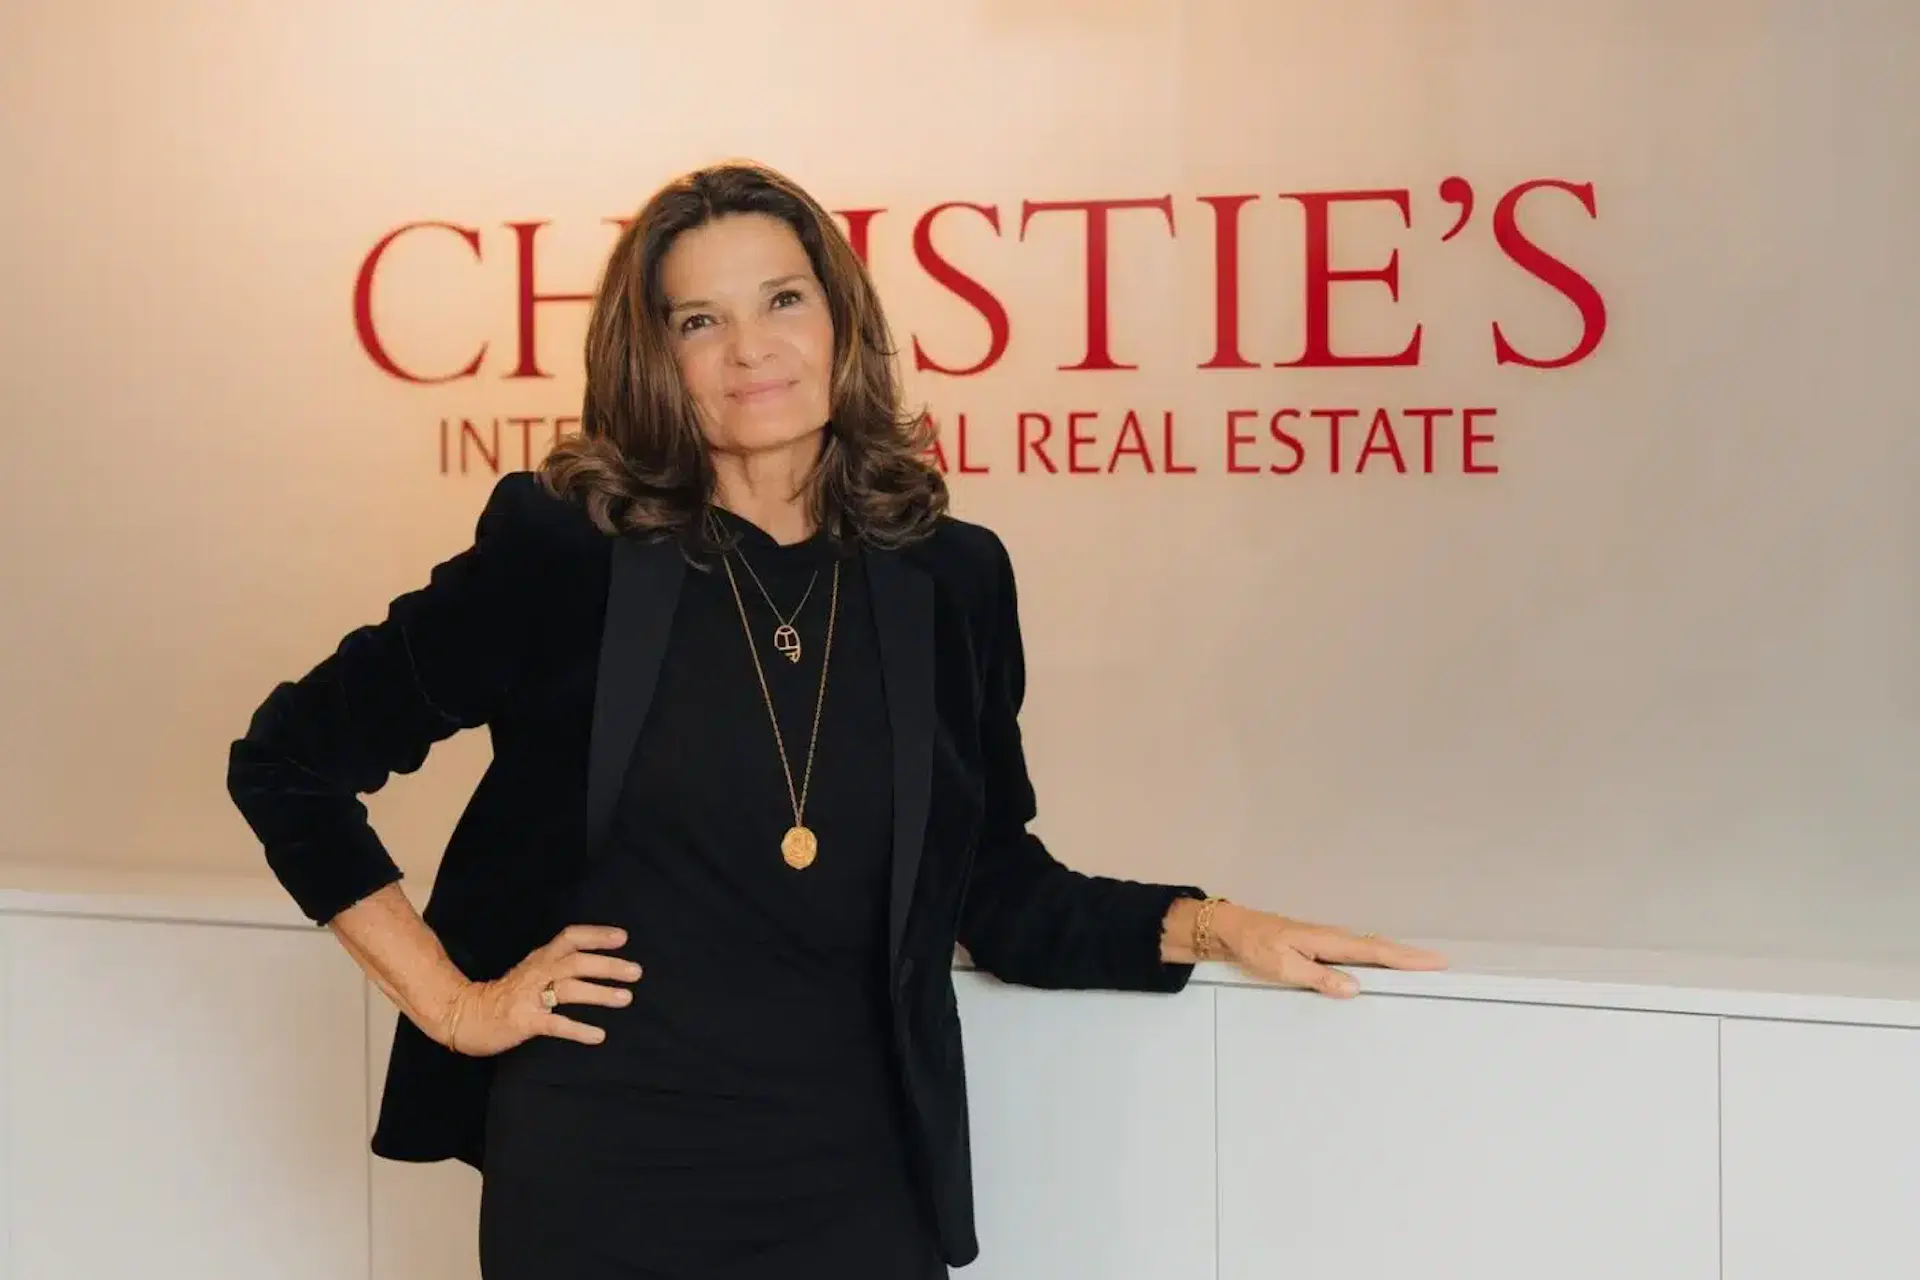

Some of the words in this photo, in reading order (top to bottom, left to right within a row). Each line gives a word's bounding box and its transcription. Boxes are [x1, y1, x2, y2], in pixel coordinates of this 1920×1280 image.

[351, 175, 1609, 386] CHSTIE’S
[1017, 409, 1198, 475] REAL
[1226, 406, 1499, 475] ESTATE
